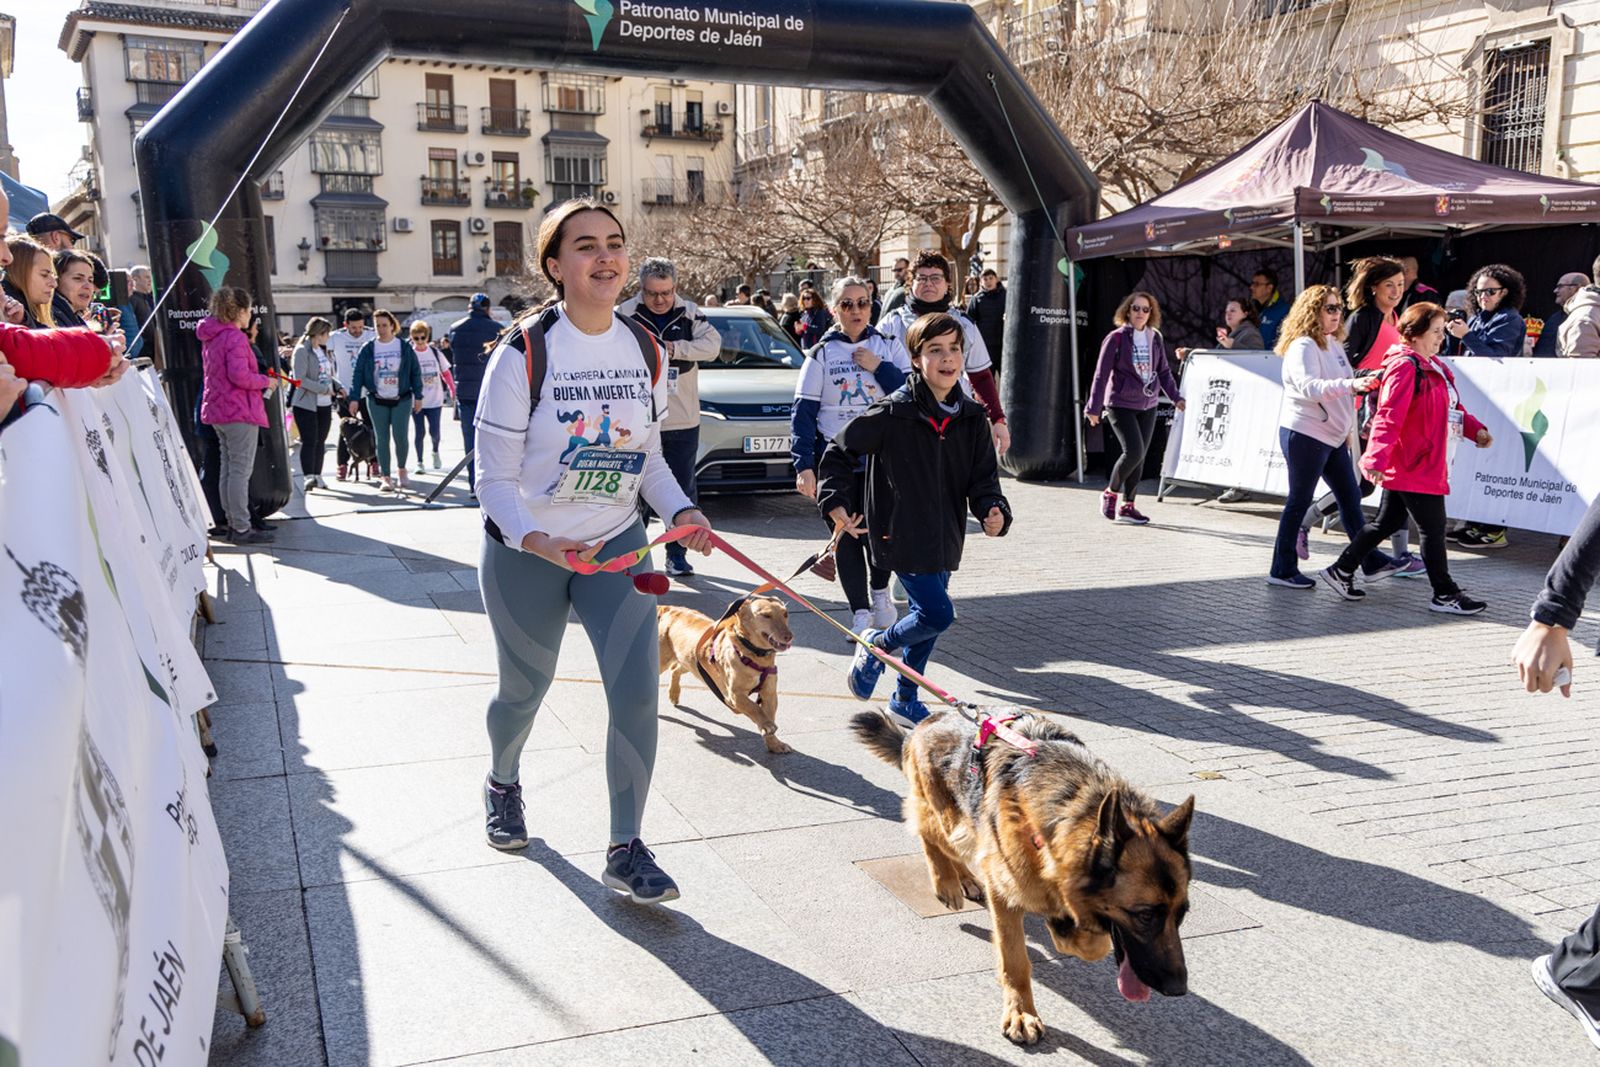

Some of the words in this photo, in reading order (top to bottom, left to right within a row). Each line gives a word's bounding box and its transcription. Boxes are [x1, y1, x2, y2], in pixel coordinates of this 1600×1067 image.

[620, 0, 700, 22] Patronato
[704, 7, 780, 31] Municipal
[784, 16, 804, 31] de
[620, 20, 695, 42] Deportes
[699, 27, 720, 44] de
[724, 29, 763, 47] Jaén
[168, 309, 211, 318] Patronato
[260, 306, 268, 314] de
[1031, 306, 1067, 316] Patronato
[563, 370, 605, 381] CARRERA
[606, 368, 649, 379] CAMINATA
[553, 386, 591, 401] BUENA
[592, 384, 637, 400] MUERTE
[753, 438, 784, 451] 5177
[577, 460, 597, 468] BUENA
[597, 459, 623, 469] MUERTE
[574, 471, 622, 493] 1128
[1475, 471, 1517, 486] Patronato
[1519, 477, 1563, 492] Municipal
[1565, 482, 1578, 493] de
[1484, 485, 1524, 500] Deportes
[1526, 491, 1538, 502] de
[1539, 493, 1562, 505] Jaén
[148, 940, 186, 1035] JAÉN
